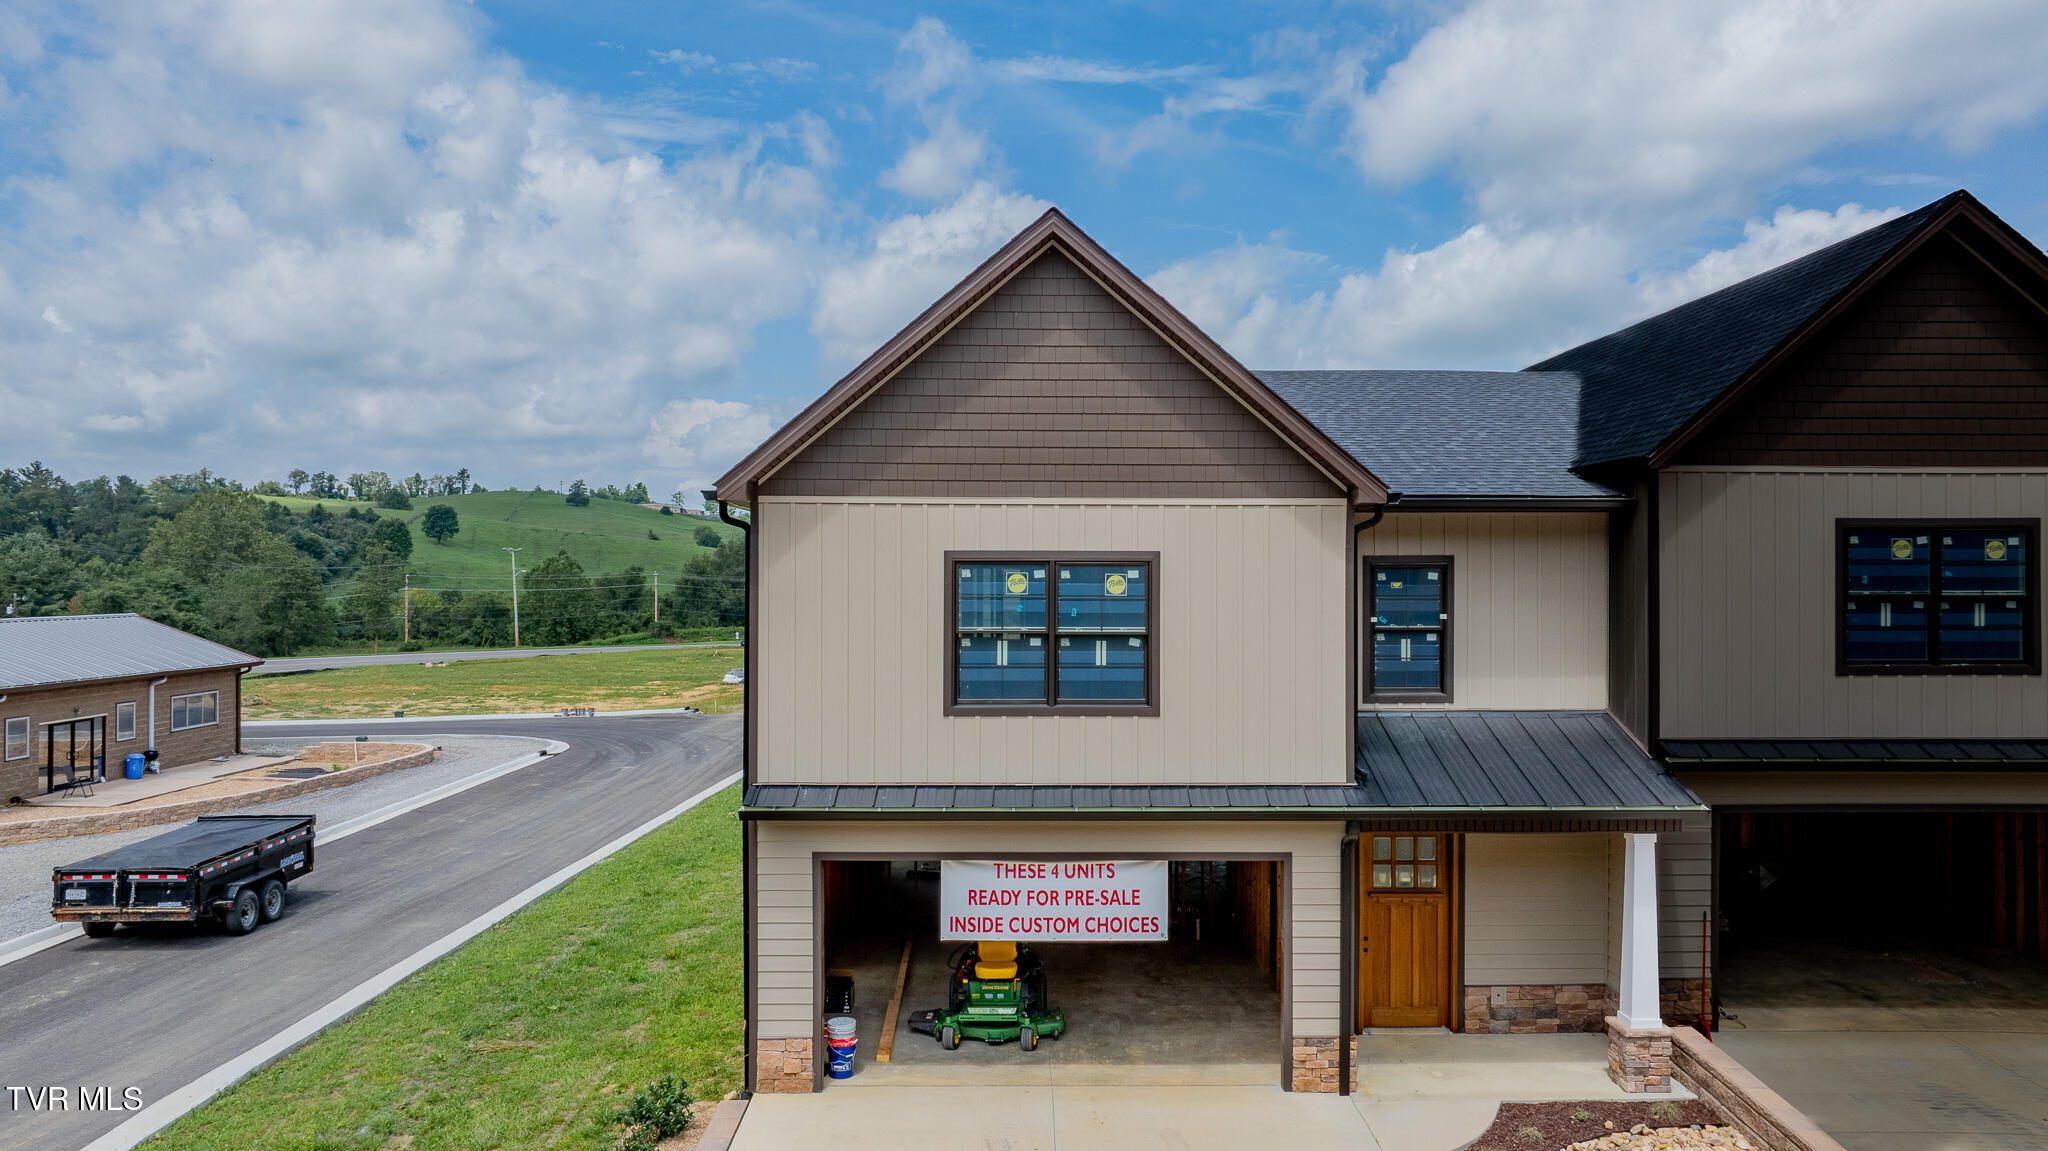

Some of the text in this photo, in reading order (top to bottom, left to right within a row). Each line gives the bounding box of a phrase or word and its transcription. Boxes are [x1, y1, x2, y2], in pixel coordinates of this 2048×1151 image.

[994, 863, 1114, 879] THESE 4 UNITS
[969, 889, 1140, 906] READY FOR PRE-SALE
[950, 917, 1159, 933] INSIDE CUSTOM CHOICES
